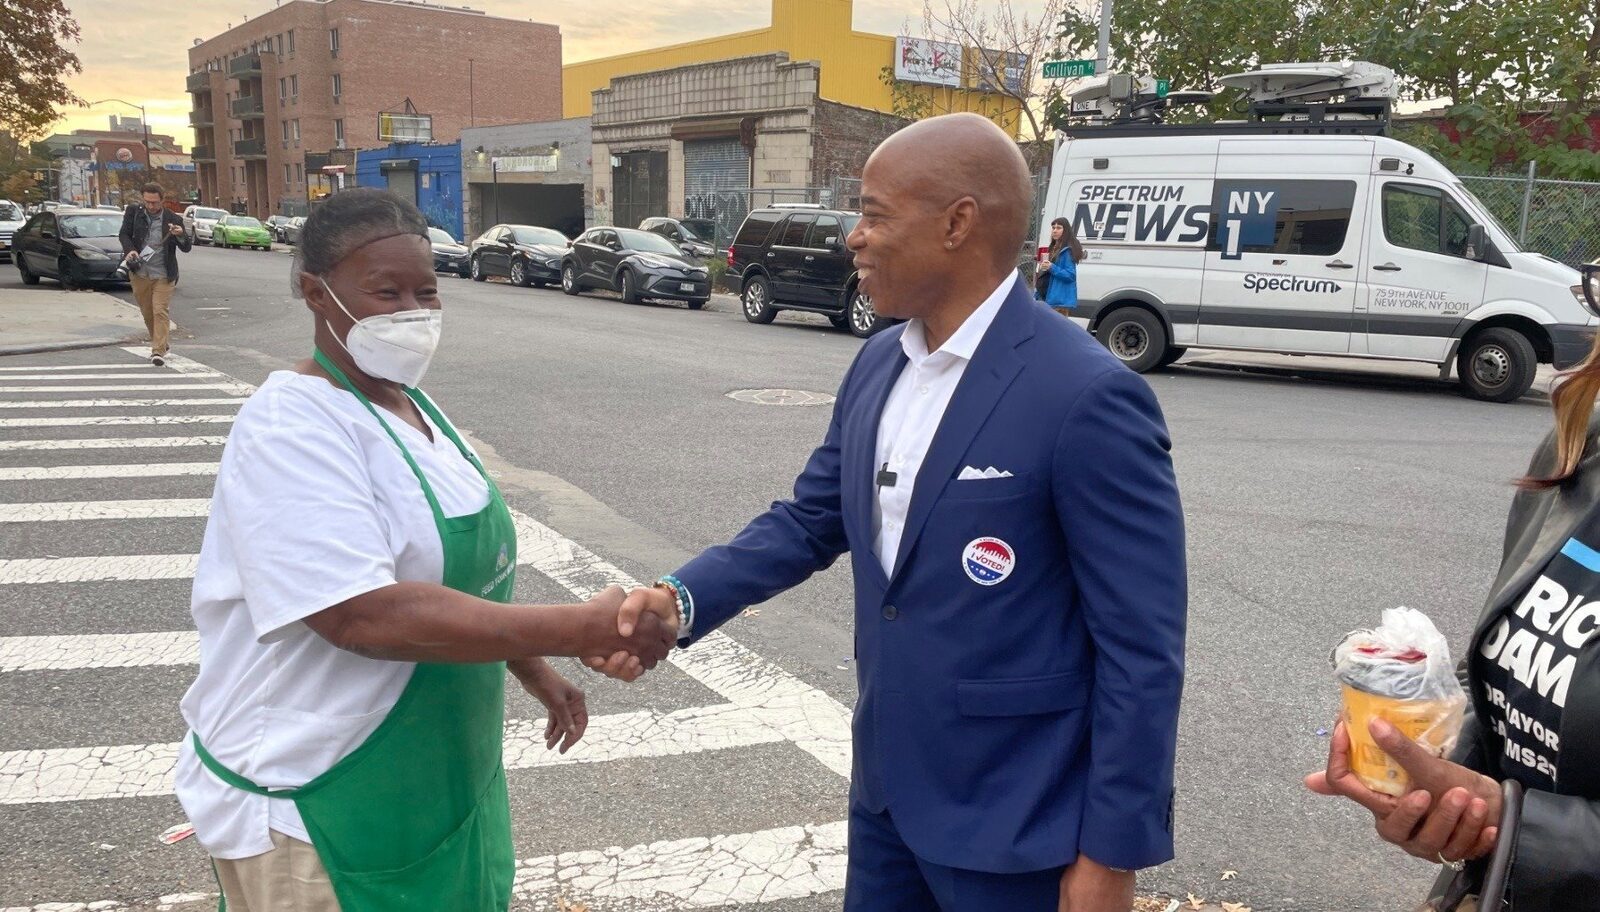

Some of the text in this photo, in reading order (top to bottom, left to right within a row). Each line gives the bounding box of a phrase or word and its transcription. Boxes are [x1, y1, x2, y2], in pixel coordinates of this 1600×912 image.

[1045, 63, 1084, 77] Sullivan
[1076, 102, 1089, 110] ONE
[1079, 185, 1184, 201] SPECTRUM
[1227, 190, 1275, 214] NY
[1072, 203, 1212, 242] NEWS
[1226, 219, 1241, 256] 1
[1243, 273, 1336, 293] Spectrum
[1376, 288, 1387, 298] 75
[1406, 291, 1447, 300] AVENUE
[1374, 299, 1470, 311] NEW YORK, NY 10011
[1515, 574, 1600, 649] RIC
[1481, 614, 1577, 708] DAM
